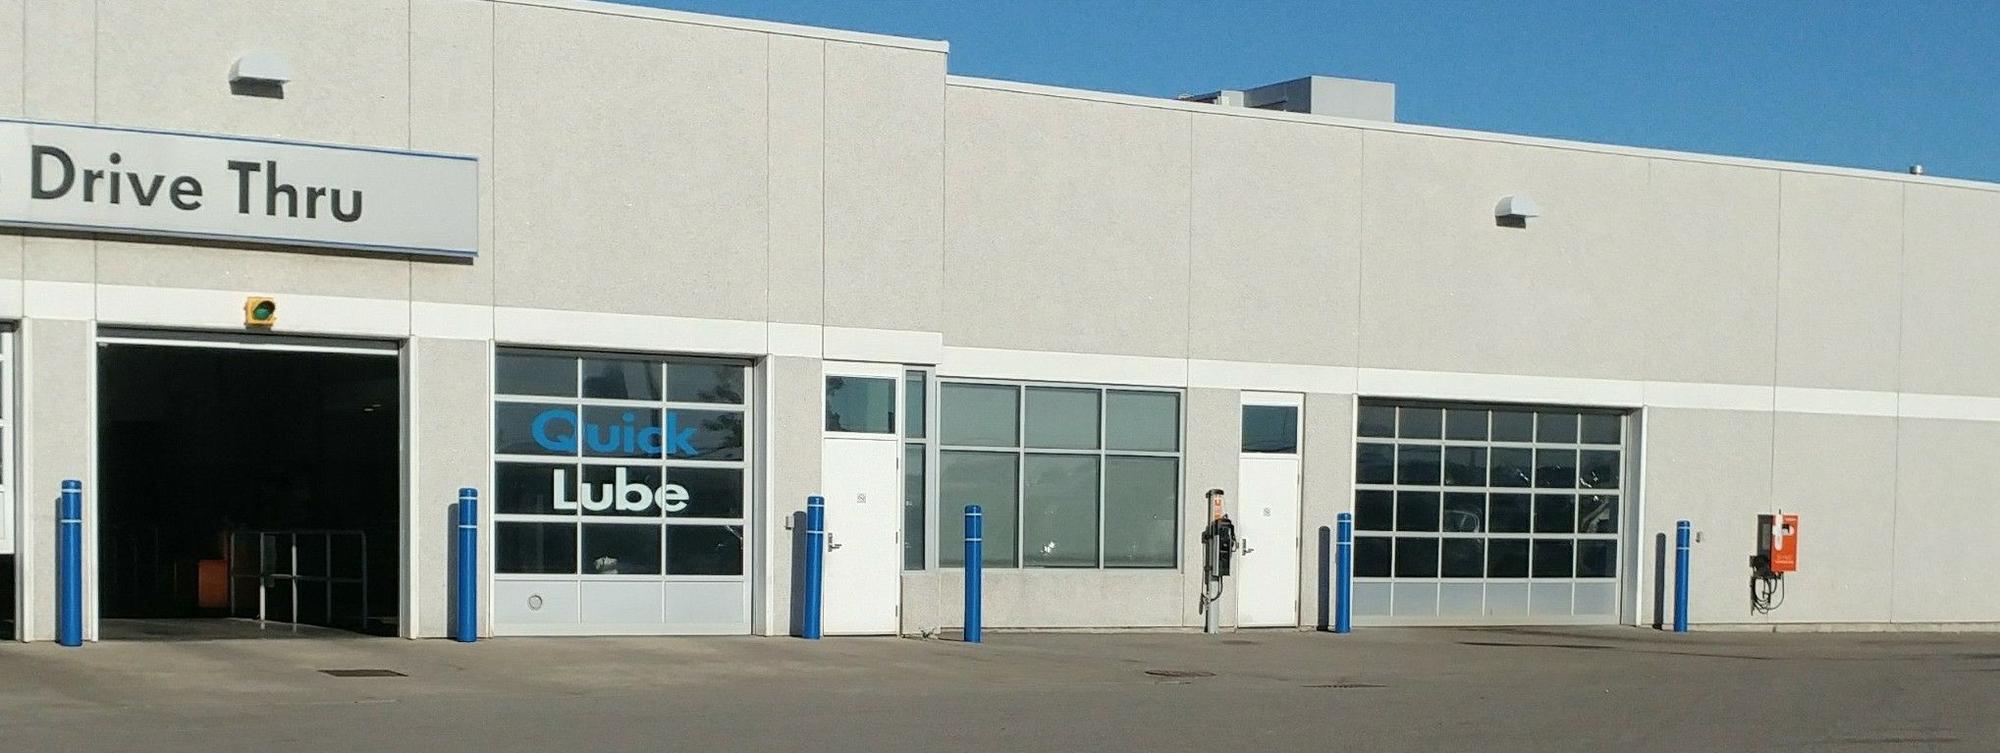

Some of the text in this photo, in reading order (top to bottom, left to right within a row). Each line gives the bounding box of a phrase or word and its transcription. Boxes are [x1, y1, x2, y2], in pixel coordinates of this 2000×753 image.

[30, 145, 363, 222] Drive Thru
[532, 409, 697, 455] Quick
[553, 466, 690, 512] Lube
